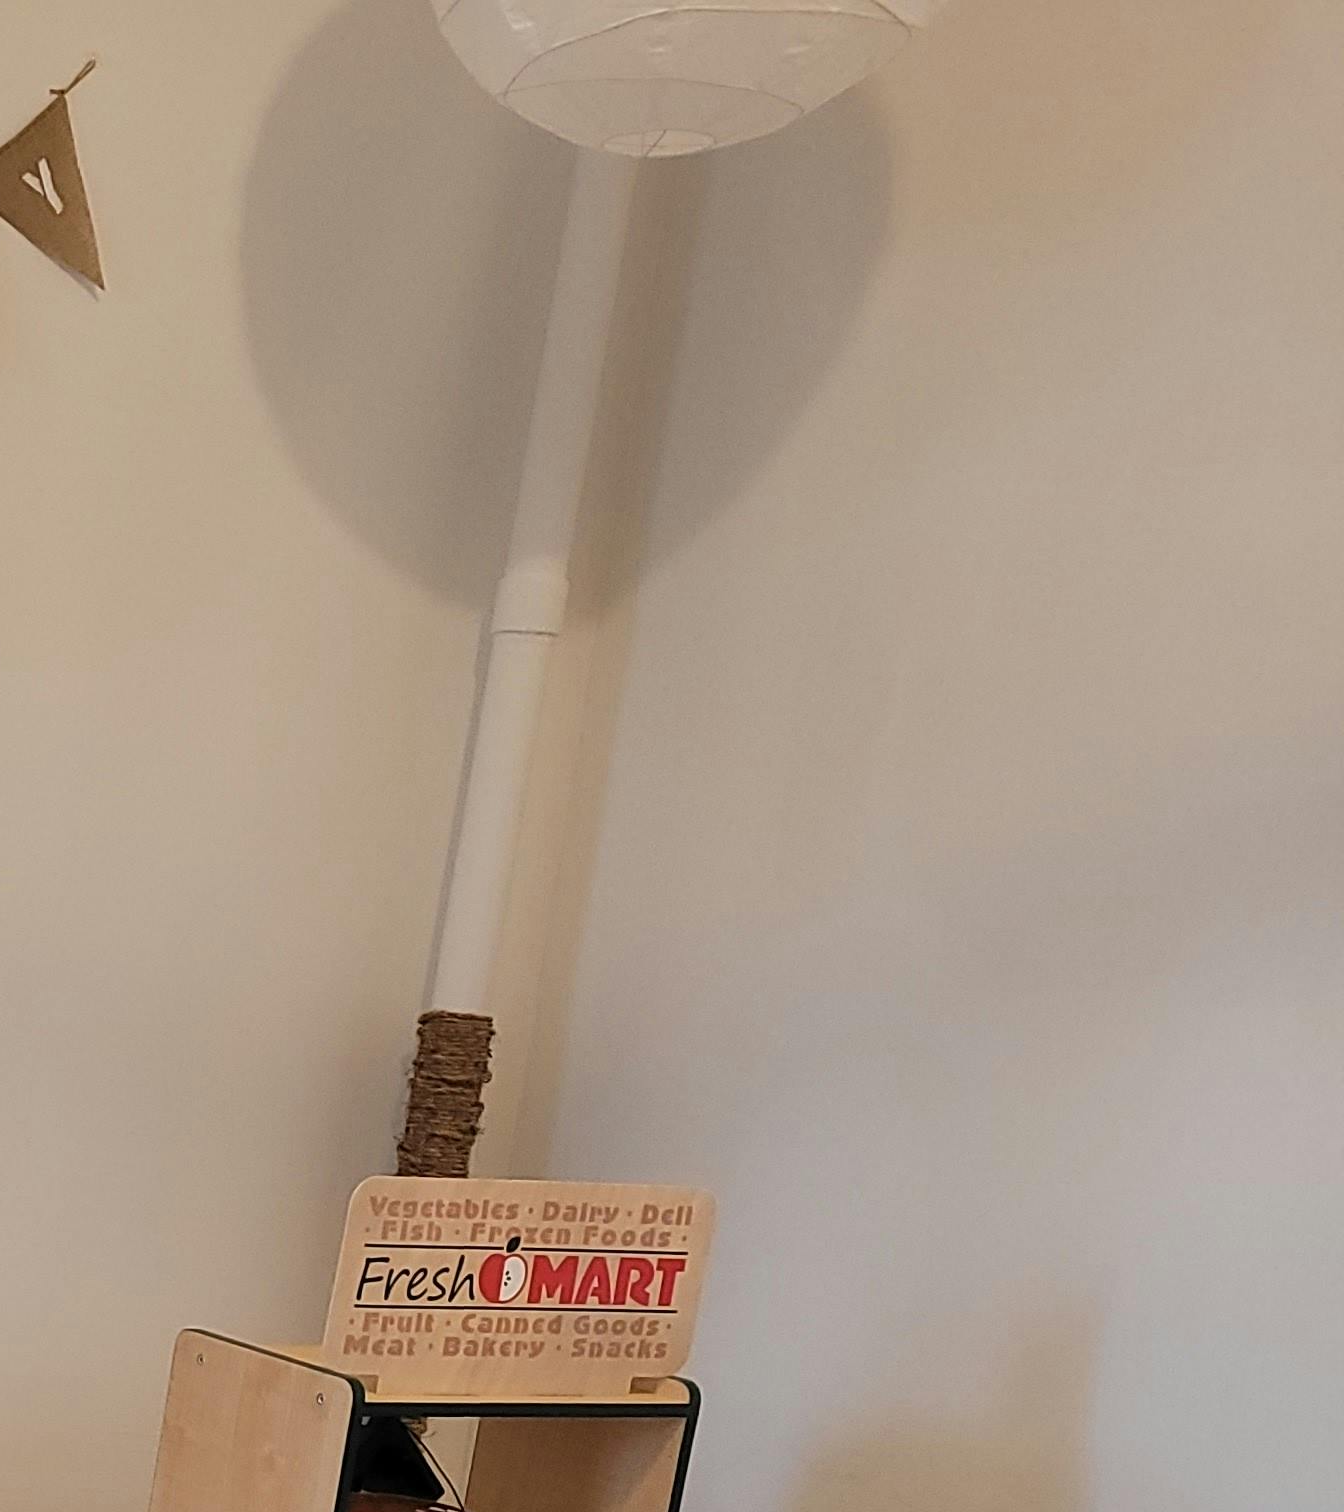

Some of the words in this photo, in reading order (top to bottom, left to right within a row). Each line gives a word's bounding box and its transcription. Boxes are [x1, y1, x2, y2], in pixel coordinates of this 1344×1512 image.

[369, 1196, 520, 1220] Vegetables
[542, 1201, 619, 1224] Dairy
[640, 1204, 693, 1226] Deli
[381, 1220, 442, 1241] Fish
[470, 1222, 571, 1245] Frozen
[582, 1225, 672, 1247] Foods
[355, 1254, 476, 1303] Fresh
[526, 1255, 687, 1307] MART
[362, 1312, 434, 1333] Fruit
[461, 1313, 562, 1335] Canned
[573, 1315, 660, 1336] Goods
[343, 1334, 416, 1357] Meat
[442, 1336, 545, 1359] Bakery
[571, 1338, 668, 1359] Snacks
